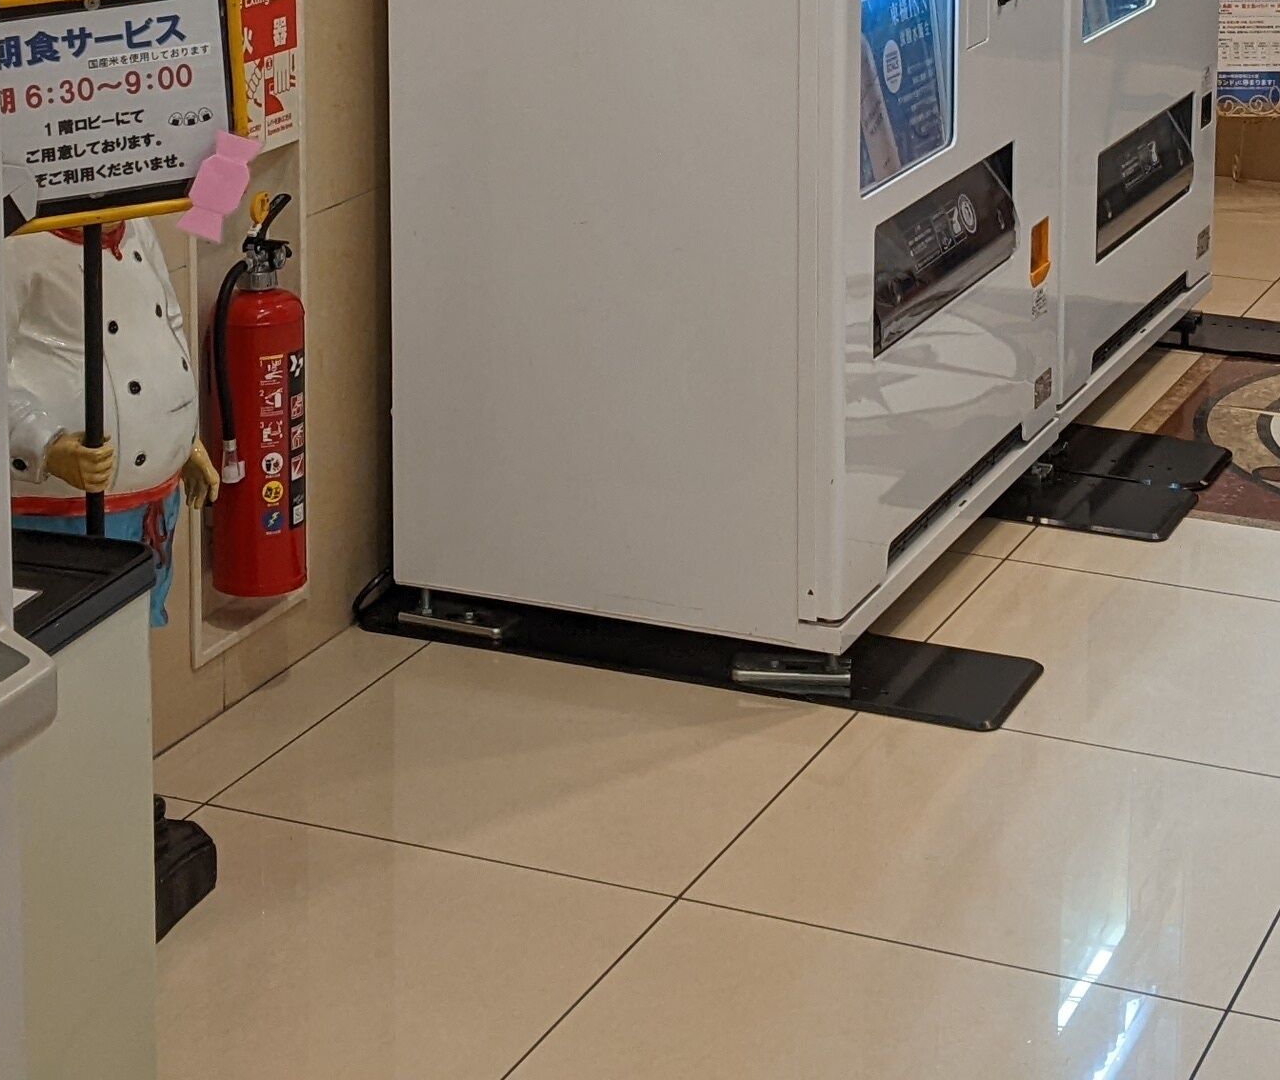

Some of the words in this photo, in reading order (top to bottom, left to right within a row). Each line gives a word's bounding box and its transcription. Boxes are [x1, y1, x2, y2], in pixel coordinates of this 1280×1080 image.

[87, 44, 210, 71] 国産米を使用しております
[45, 109, 145, 138] 1階ロビーにて
[26, 133, 163, 165] ご用意しております。
